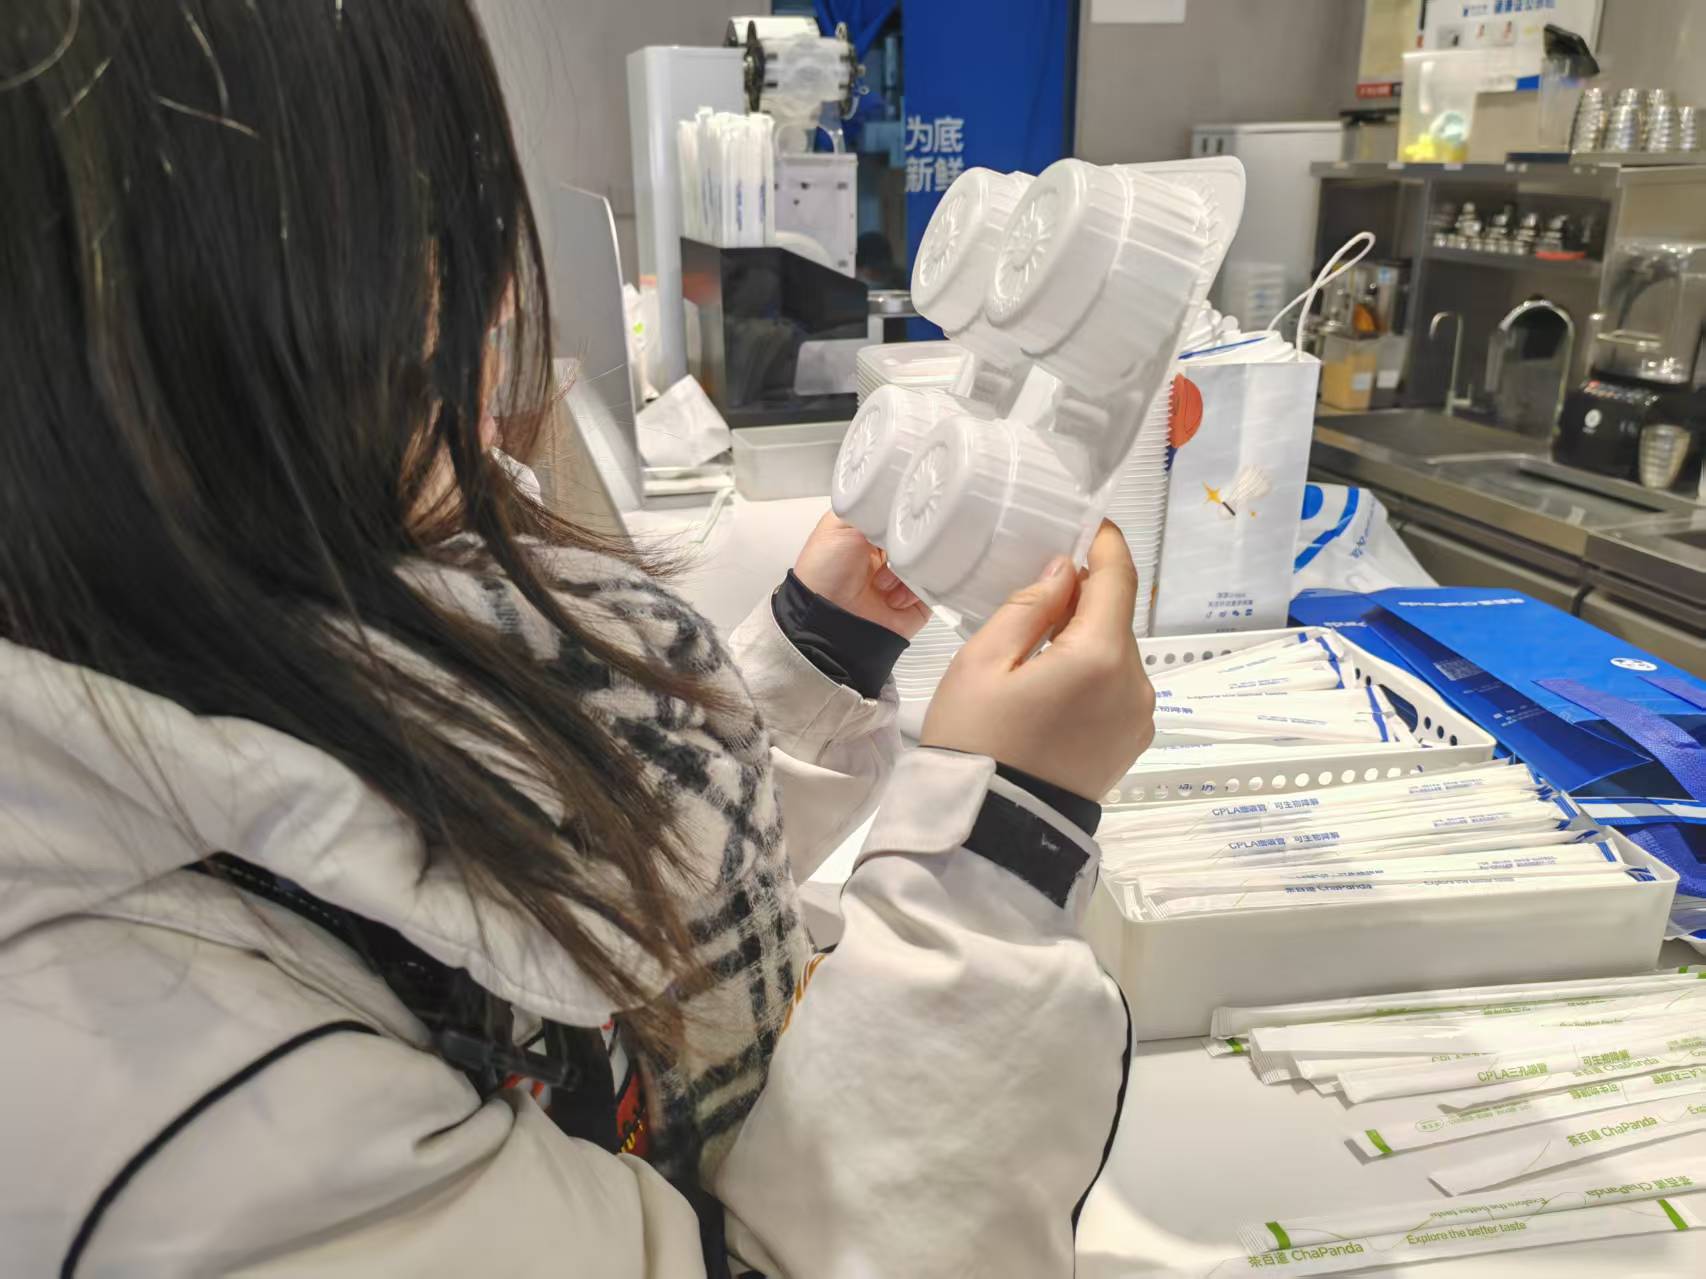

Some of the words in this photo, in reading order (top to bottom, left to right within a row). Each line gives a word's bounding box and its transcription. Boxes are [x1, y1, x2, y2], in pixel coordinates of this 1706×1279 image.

[904, 115, 964, 152] 为底
[904, 157, 964, 192] 新鲜
[1601, 1115, 1658, 1137] ChaPanda
[1586, 1182, 1653, 1198] ChaPanda
[1406, 1230, 1448, 1246] Explore
[1448, 1229, 1466, 1239] the
[1467, 1225, 1498, 1237] better
[1500, 1220, 1527, 1233] taste
[1248, 1253, 1290, 1268] 茶百道
[1291, 1240, 1364, 1262] ChaPanda
